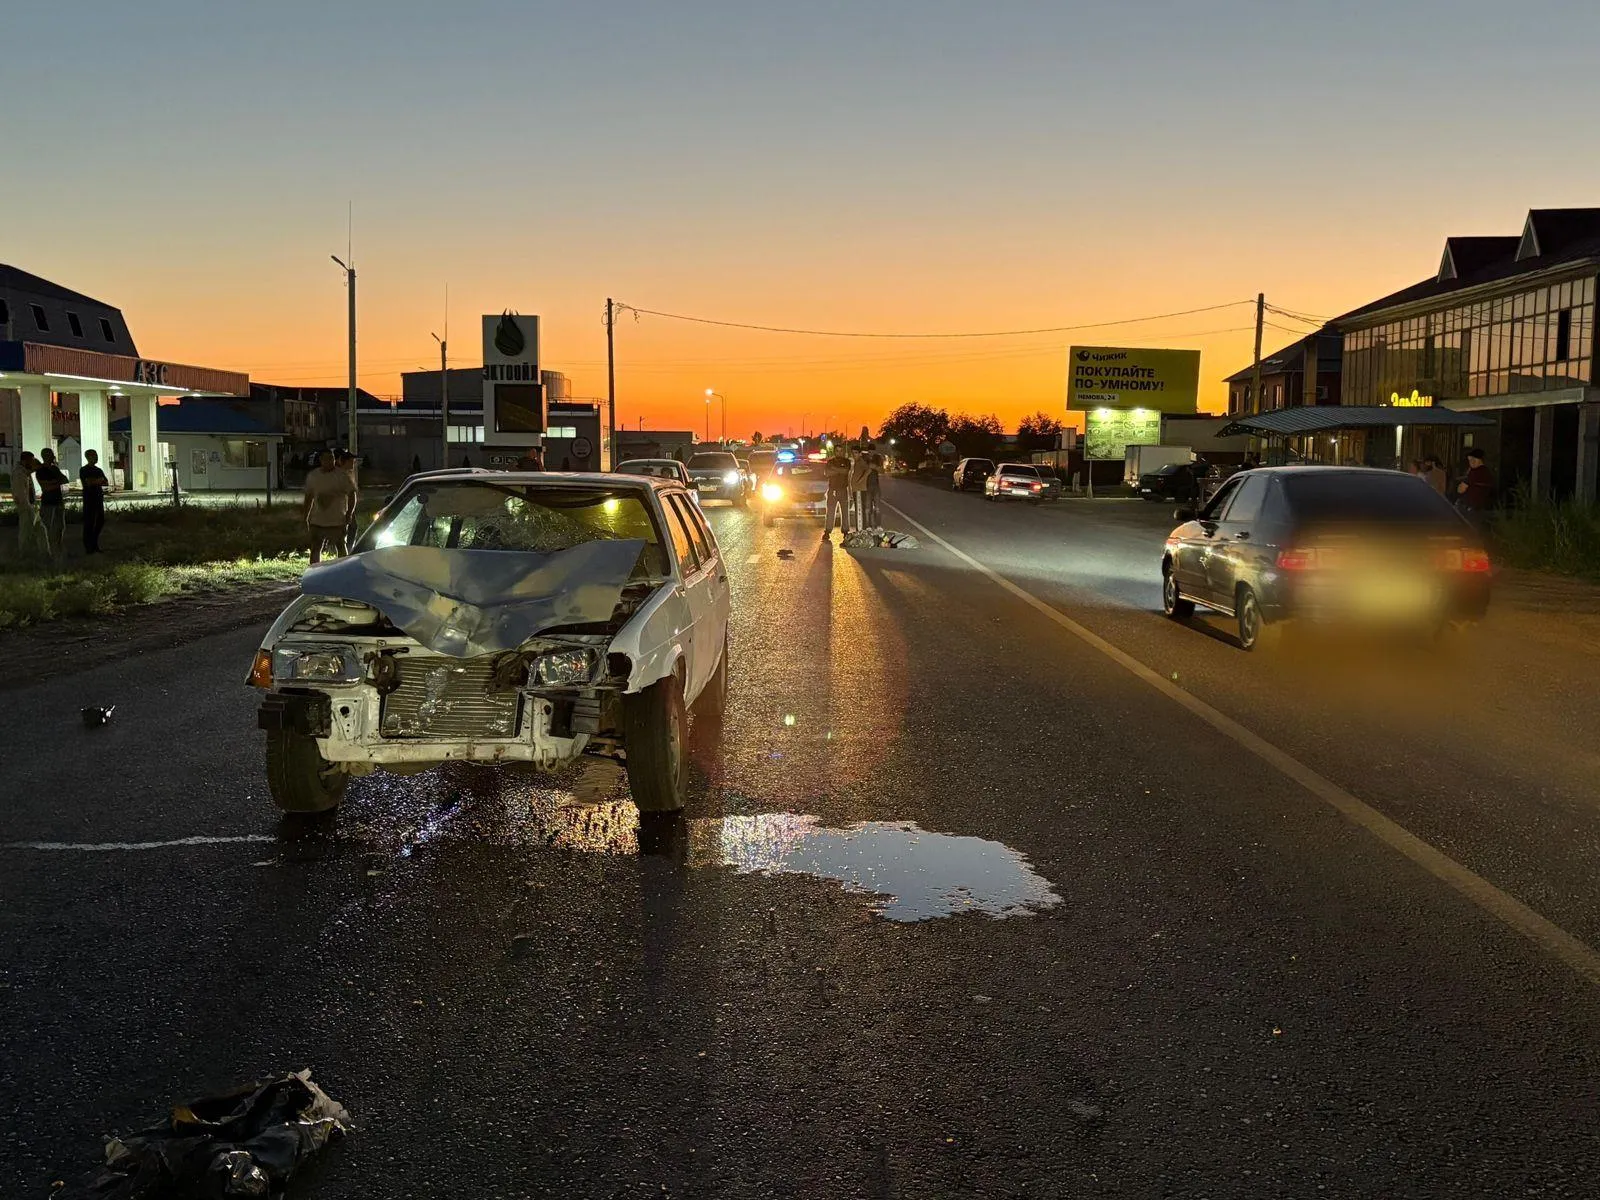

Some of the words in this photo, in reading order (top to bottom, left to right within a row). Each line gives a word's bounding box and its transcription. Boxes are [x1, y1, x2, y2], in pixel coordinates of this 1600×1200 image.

[135, 360, 169, 386] АЗС
[1075, 365, 1155, 378] ПОКУПАЙТЕ
[1075, 379, 1165, 391] ПО-УМНОМУ!
